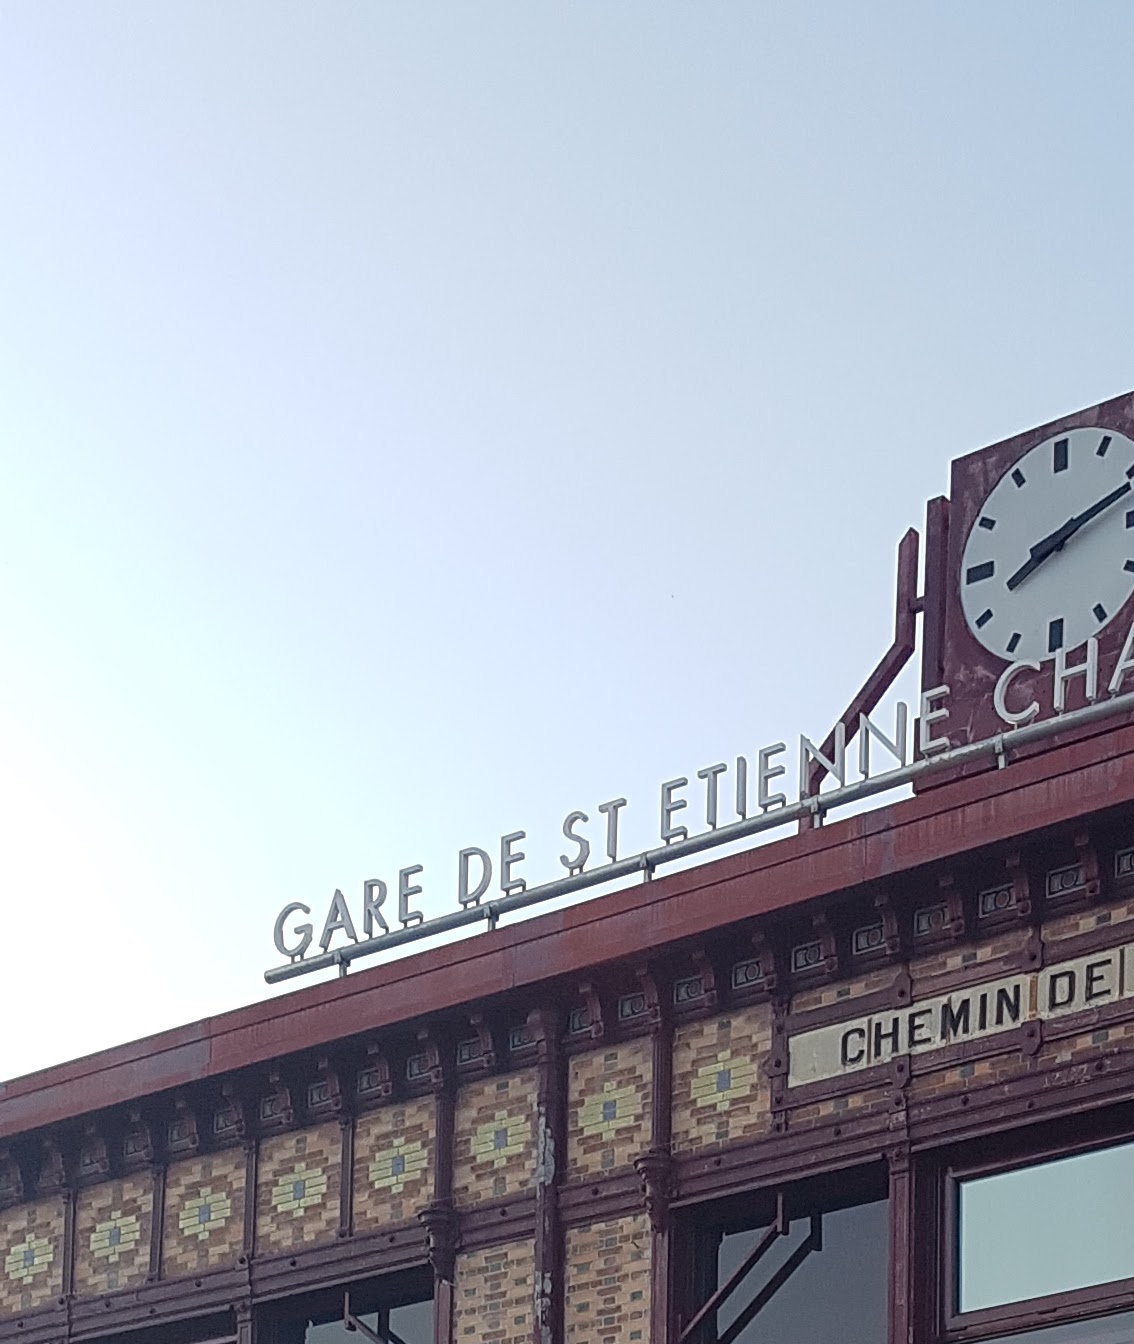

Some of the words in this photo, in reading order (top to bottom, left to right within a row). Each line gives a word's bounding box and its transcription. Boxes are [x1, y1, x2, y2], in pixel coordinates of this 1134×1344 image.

[273, 864, 424, 958] GARE
[458, 830, 526, 905] DE
[560, 797, 627, 870] ST
[661, 684, 950, 841] ETIENNE
[840, 983, 1021, 1067] CHEMIN
[1048, 958, 1113, 1009] DE
